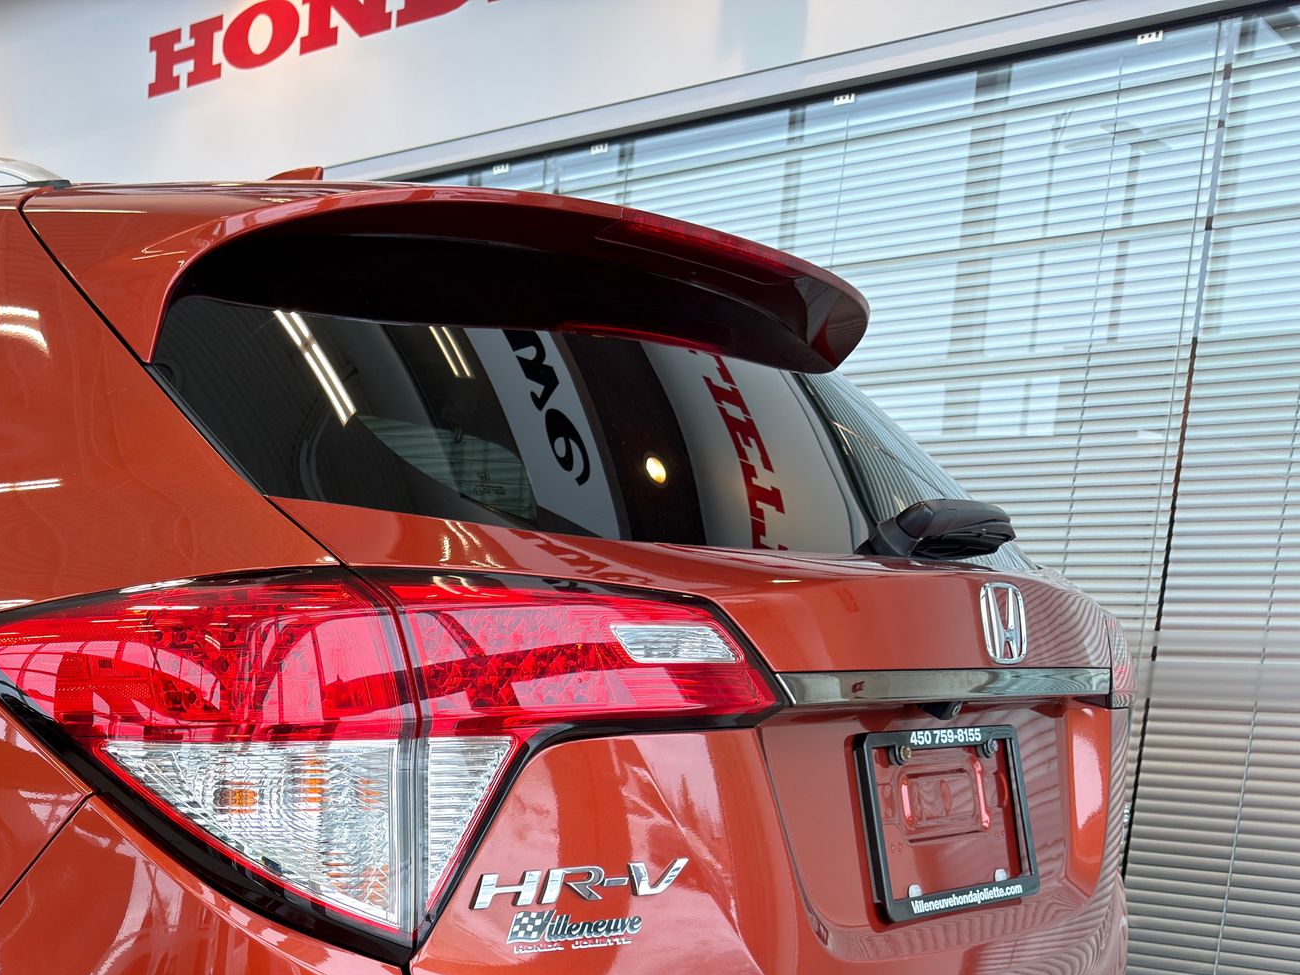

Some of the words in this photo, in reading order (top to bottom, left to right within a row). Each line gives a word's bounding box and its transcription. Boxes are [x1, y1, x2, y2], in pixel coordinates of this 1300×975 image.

[148, 0, 501, 98] HON
[909, 730, 932, 746] 450
[932, 727, 983, 745] 759-8155
[468, 857, 689, 910] HR-V
[910, 883, 1023, 915] Villeneuvehondajoliette.com
[538, 908, 643, 943] Villeneuve
